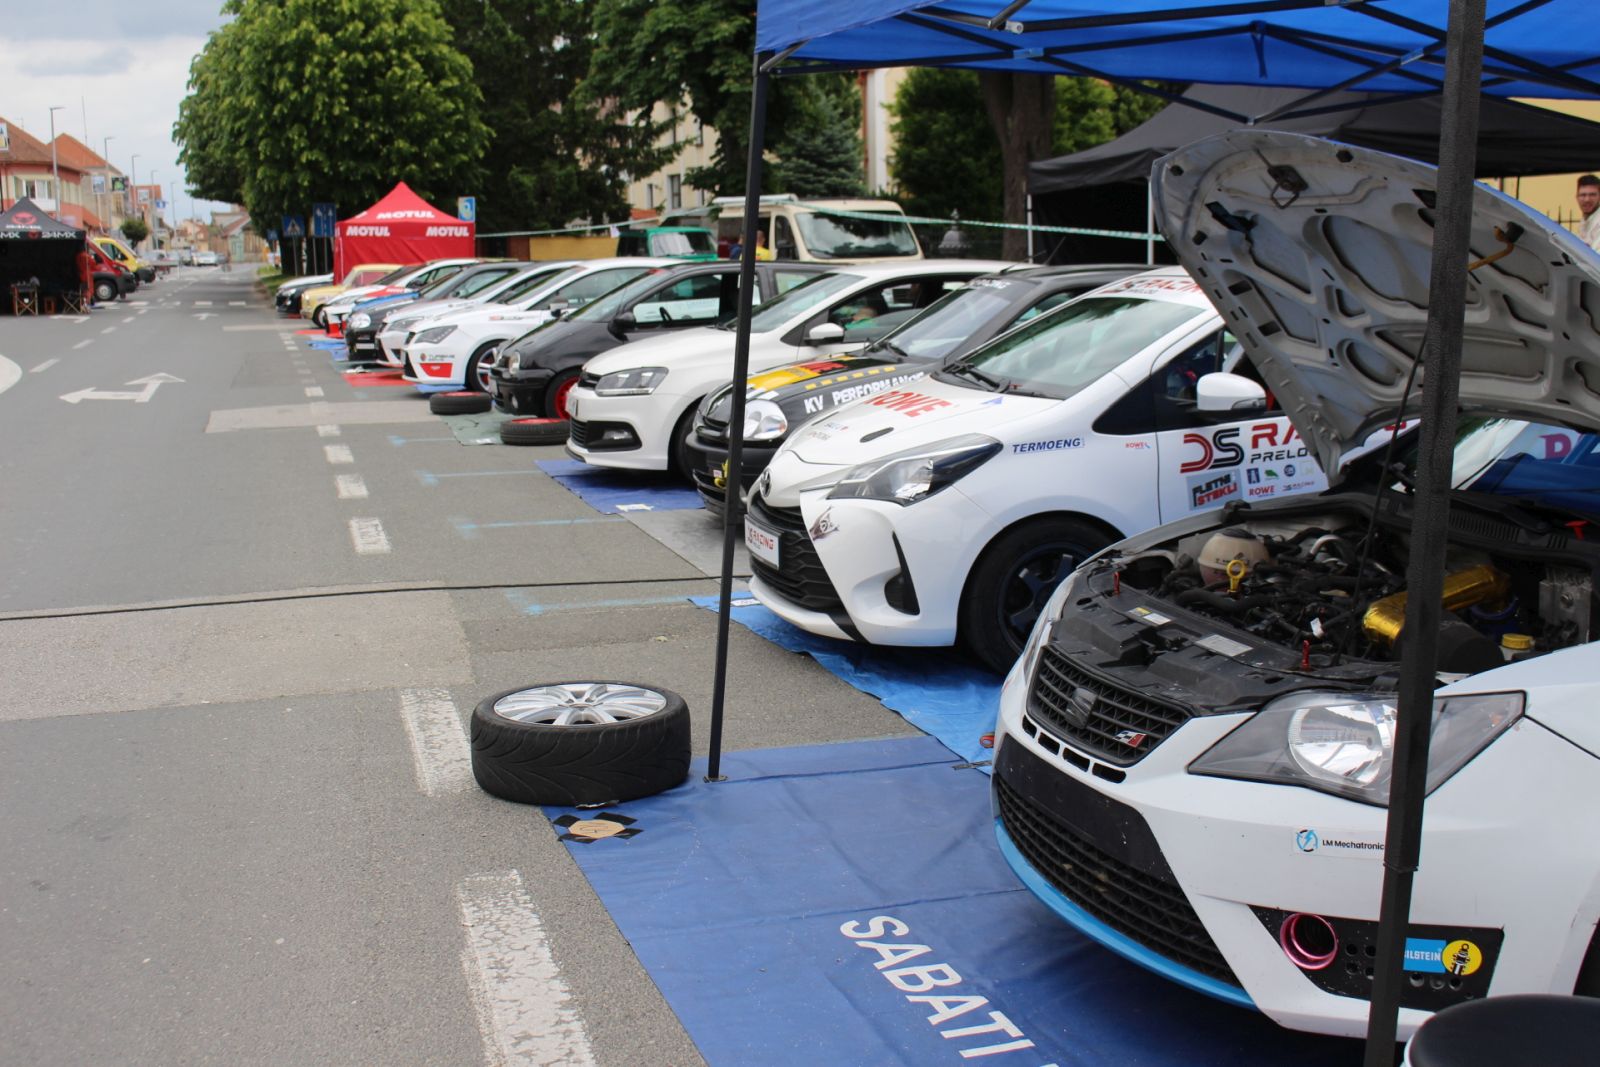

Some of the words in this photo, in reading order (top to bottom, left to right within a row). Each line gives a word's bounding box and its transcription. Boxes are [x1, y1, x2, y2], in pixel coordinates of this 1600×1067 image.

[376, 210, 435, 219] MOTUL
[346, 226, 390, 237] MOTUL
[425, 226, 469, 237] MOTUL
[803, 394, 824, 414] KV
[1012, 438, 1081, 454] TERMOENG
[1180, 427, 1245, 473] DS
[1249, 485, 1276, 496] ROWE
[1322, 839, 1333, 847] LM
[1334, 840, 1385, 850] Mechatronic
[840, 915, 1060, 1067] SABATI
